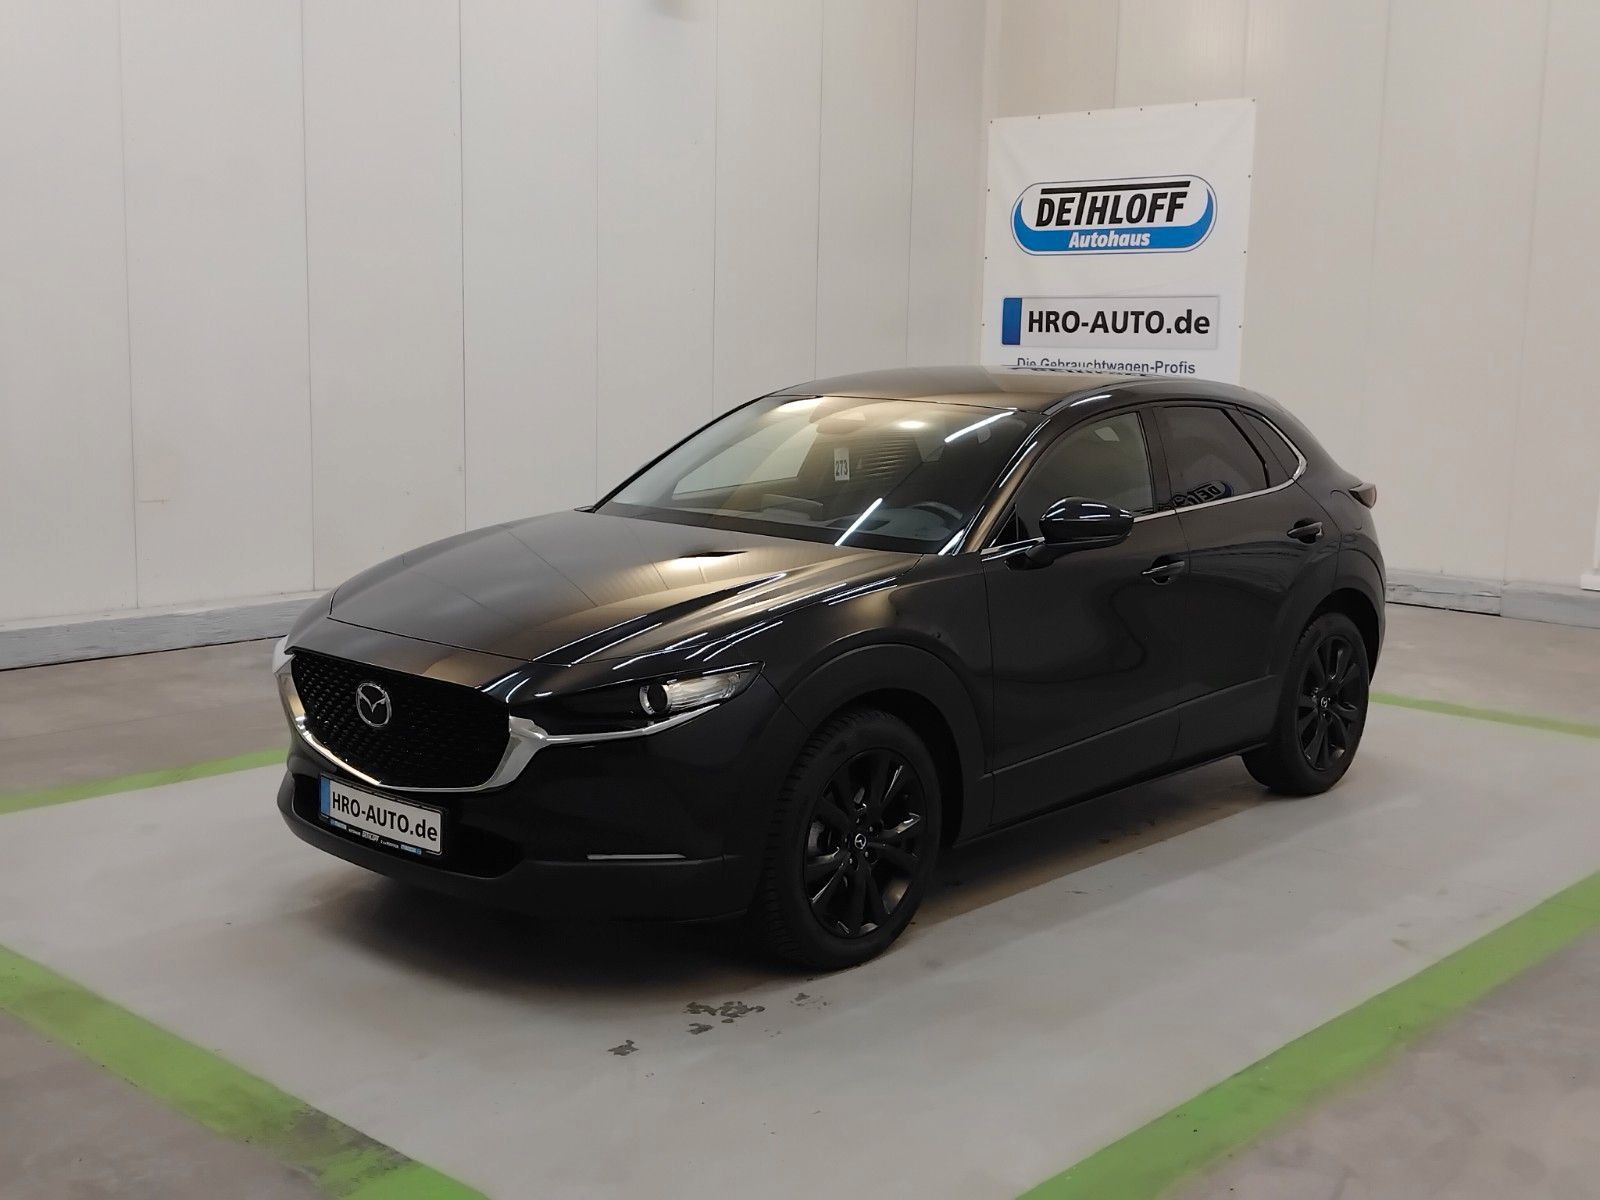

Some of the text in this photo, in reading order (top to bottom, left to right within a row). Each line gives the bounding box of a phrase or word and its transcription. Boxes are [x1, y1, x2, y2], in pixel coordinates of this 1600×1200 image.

[1036, 181, 1190, 227] DETHLOFF
[1068, 231, 1150, 248] Autohaus
[1028, 309, 1210, 334] HRO-AUTO.de
[835, 459, 848, 476] 273
[332, 791, 438, 842] HRO-AUTO.de
